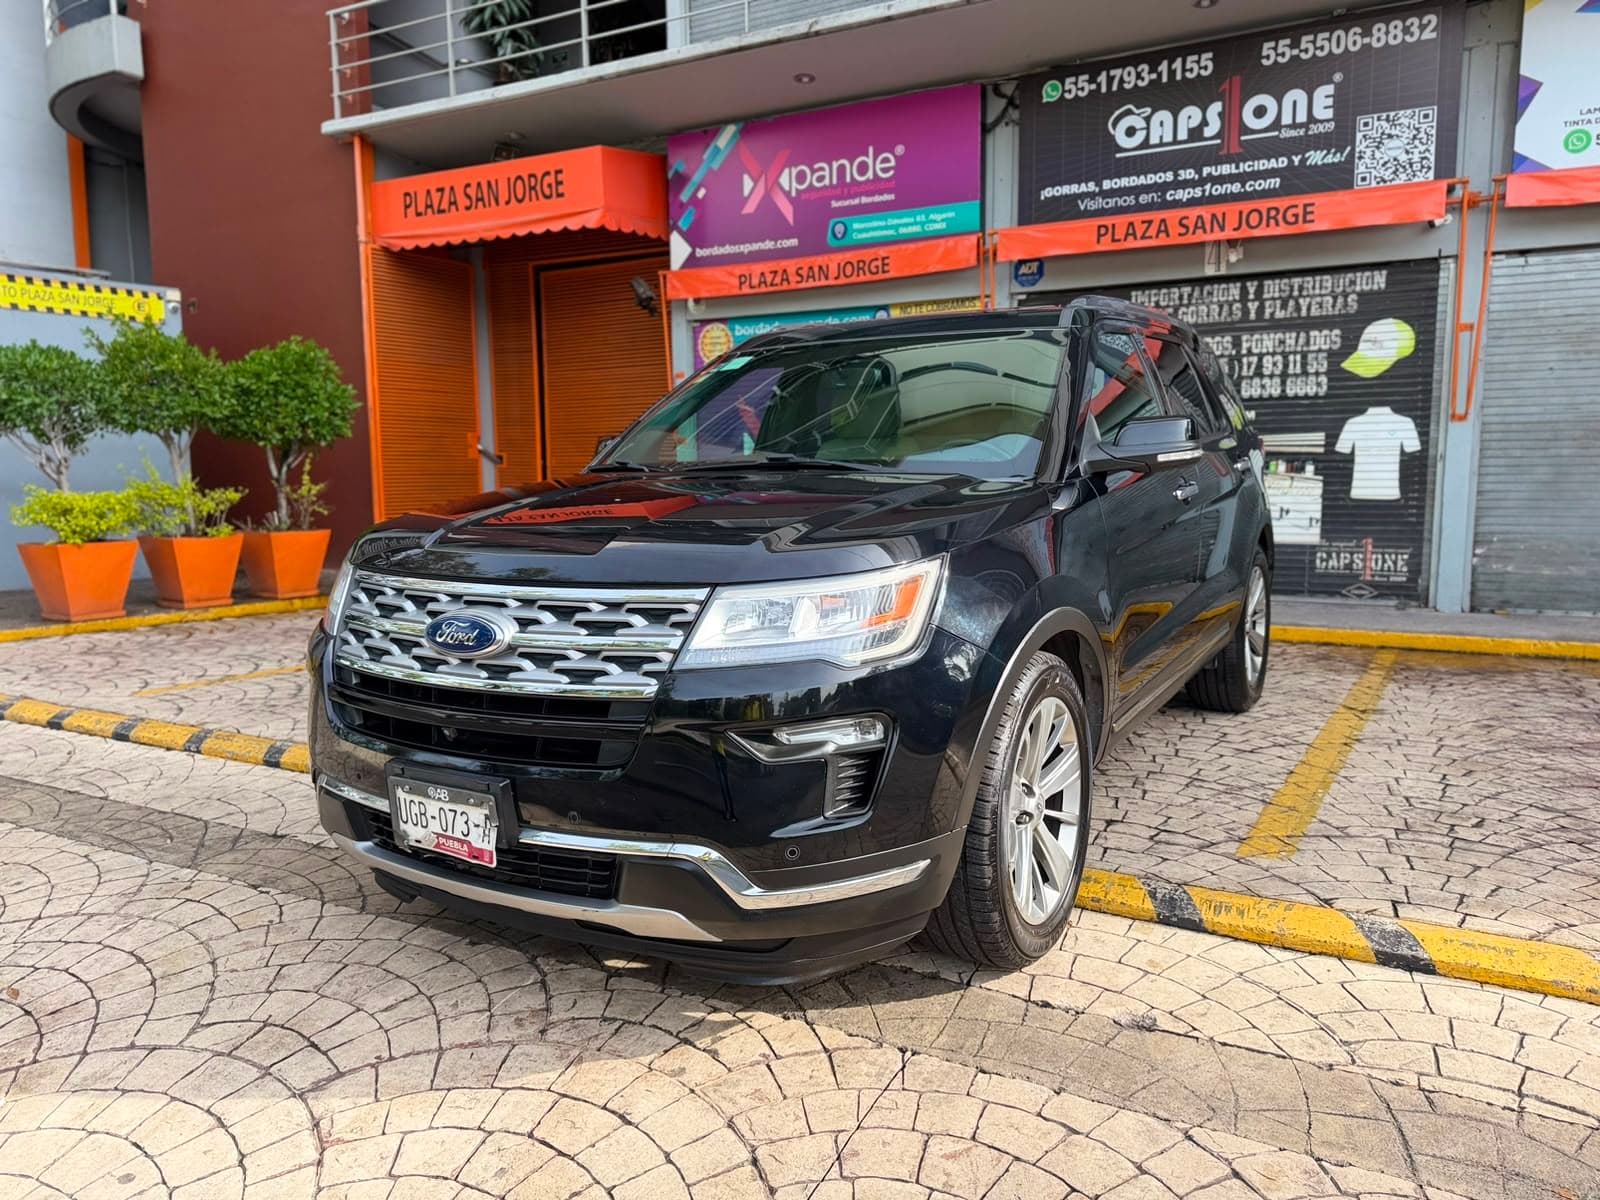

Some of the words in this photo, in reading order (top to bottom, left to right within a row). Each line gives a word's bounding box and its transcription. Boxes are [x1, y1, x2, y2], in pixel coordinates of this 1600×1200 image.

[1261, 14, 1438, 66] 55-5506-8832
[1063, 52, 1214, 99] 55-1793-1155
[1279, 126, 1306, 139] Since
[1308, 121, 1336, 136] 2009
[1563, 118, 1593, 128] TINTA
[1040, 181, 1099, 200] ¡GORRAS,
[1102, 171, 1174, 190] BORDADOS
[1177, 168, 1199, 182] 3D,
[1202, 157, 1288, 177] PUBLICIDAD
[1292, 155, 1302, 166] Y
[1304, 146, 1352, 166] Más!
[403, 186, 460, 219] PLAZA
[463, 177, 501, 211] SAN
[504, 169, 566, 206] JORGE
[1139, 191, 1162, 205] en:
[1166, 176, 1281, 202] caps1one.com
[1096, 218, 1171, 245] PLAZA
[1177, 212, 1227, 237] SAN
[1233, 202, 1316, 232] JORGE
[695, 238, 799, 257] bordadosxpande.com
[738, 269, 791, 290] PLAZA
[795, 263, 830, 283] SAN
[834, 256, 890, 280] JORGE
[1130, 282, 1241, 306] IMPORTACION
[1246, 280, 1259, 299] Y
[1262, 269, 1388, 299] DISTRIBUCION
[20, 287, 55, 303] PLAZA
[58, 293, 80, 305] SAN
[83, 295, 117, 309] JORGE
[1178, 302, 1242, 325] GORRAS
[1247, 301, 1260, 320] Y
[1264, 294, 1359, 320] PLAYERAS
[1241, 329, 1341, 355] PONCHADOS
[1241, 356, 1258, 376] 17
[1262, 354, 1283, 375] 93
[1287, 354, 1301, 374] 11
[1306, 352, 1328, 373] 55
[436, 620, 480, 645] Ford
[438, 836, 469, 852] PUEBLA
